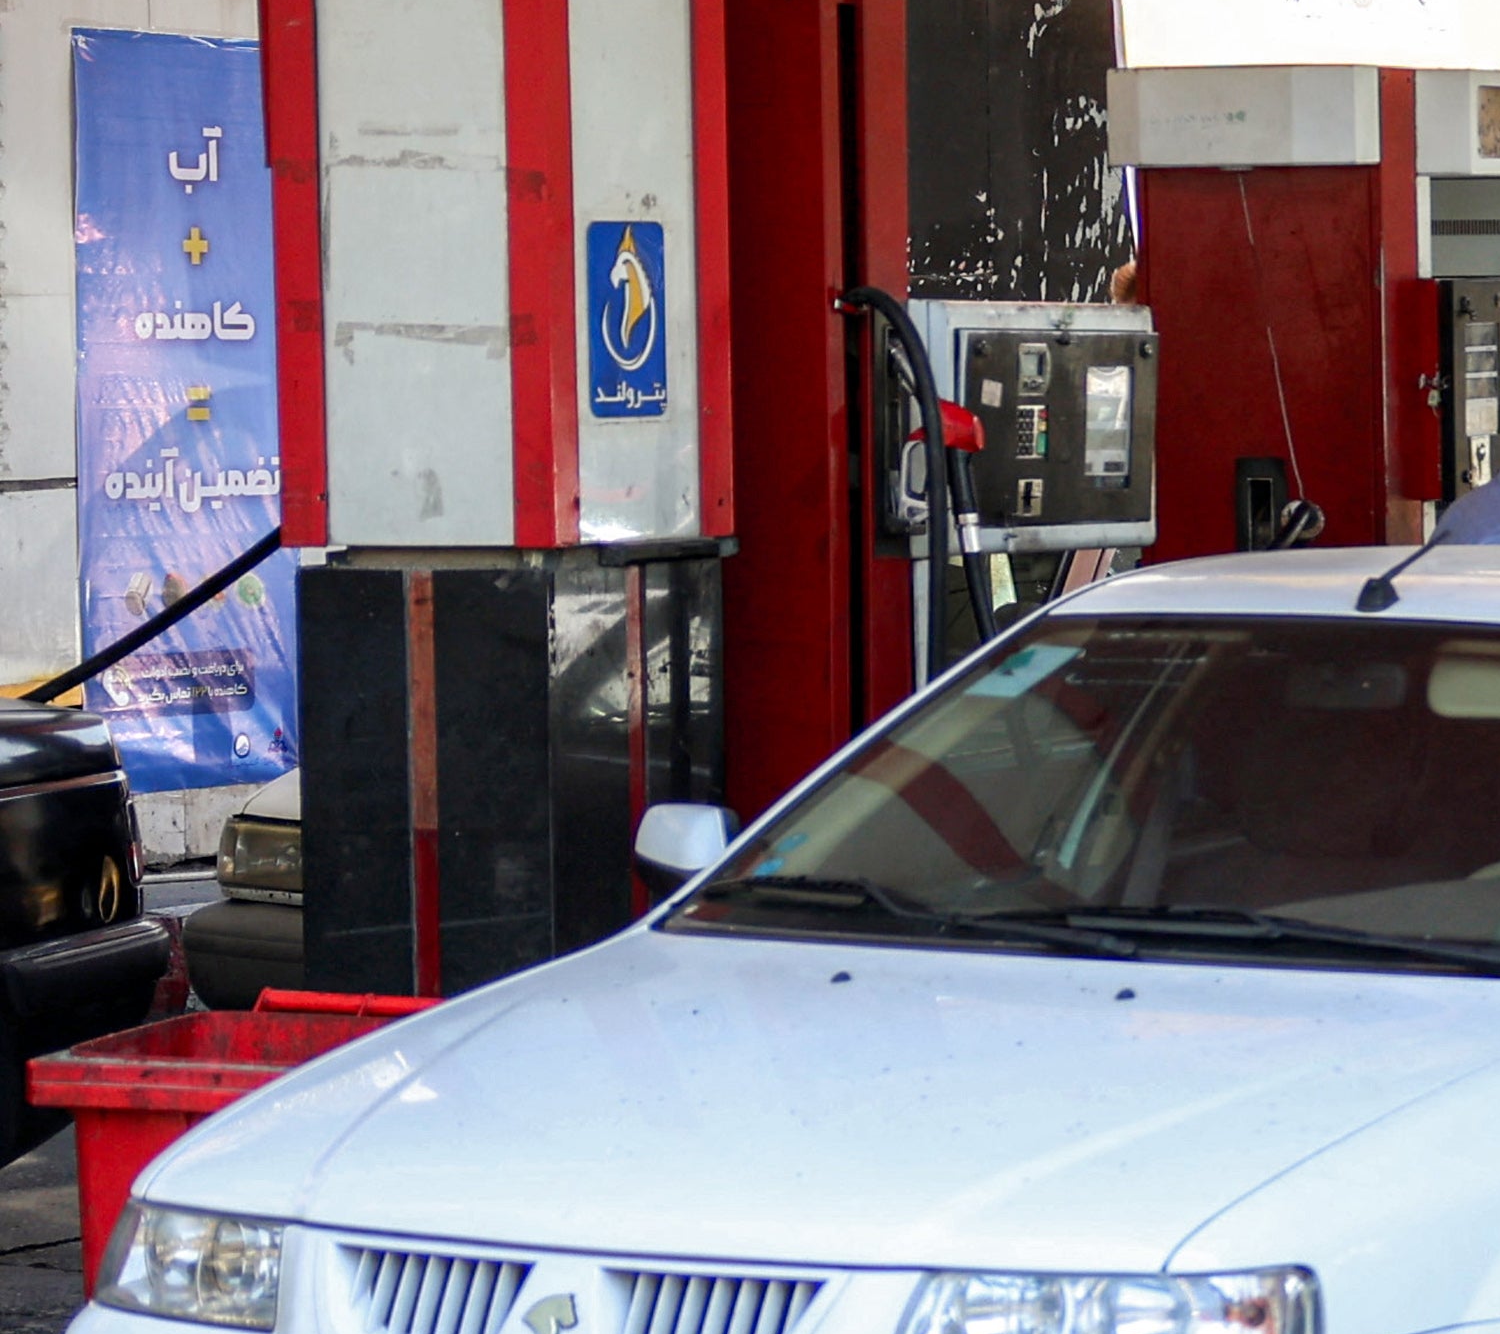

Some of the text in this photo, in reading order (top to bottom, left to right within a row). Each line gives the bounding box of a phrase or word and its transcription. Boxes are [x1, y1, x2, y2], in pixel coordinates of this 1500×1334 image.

[168, 127, 223, 193] آب
[134, 300, 255, 343] کاهنده
[595, 381, 667, 411] پترولند
[104, 446, 280, 513] تضمین آینده
